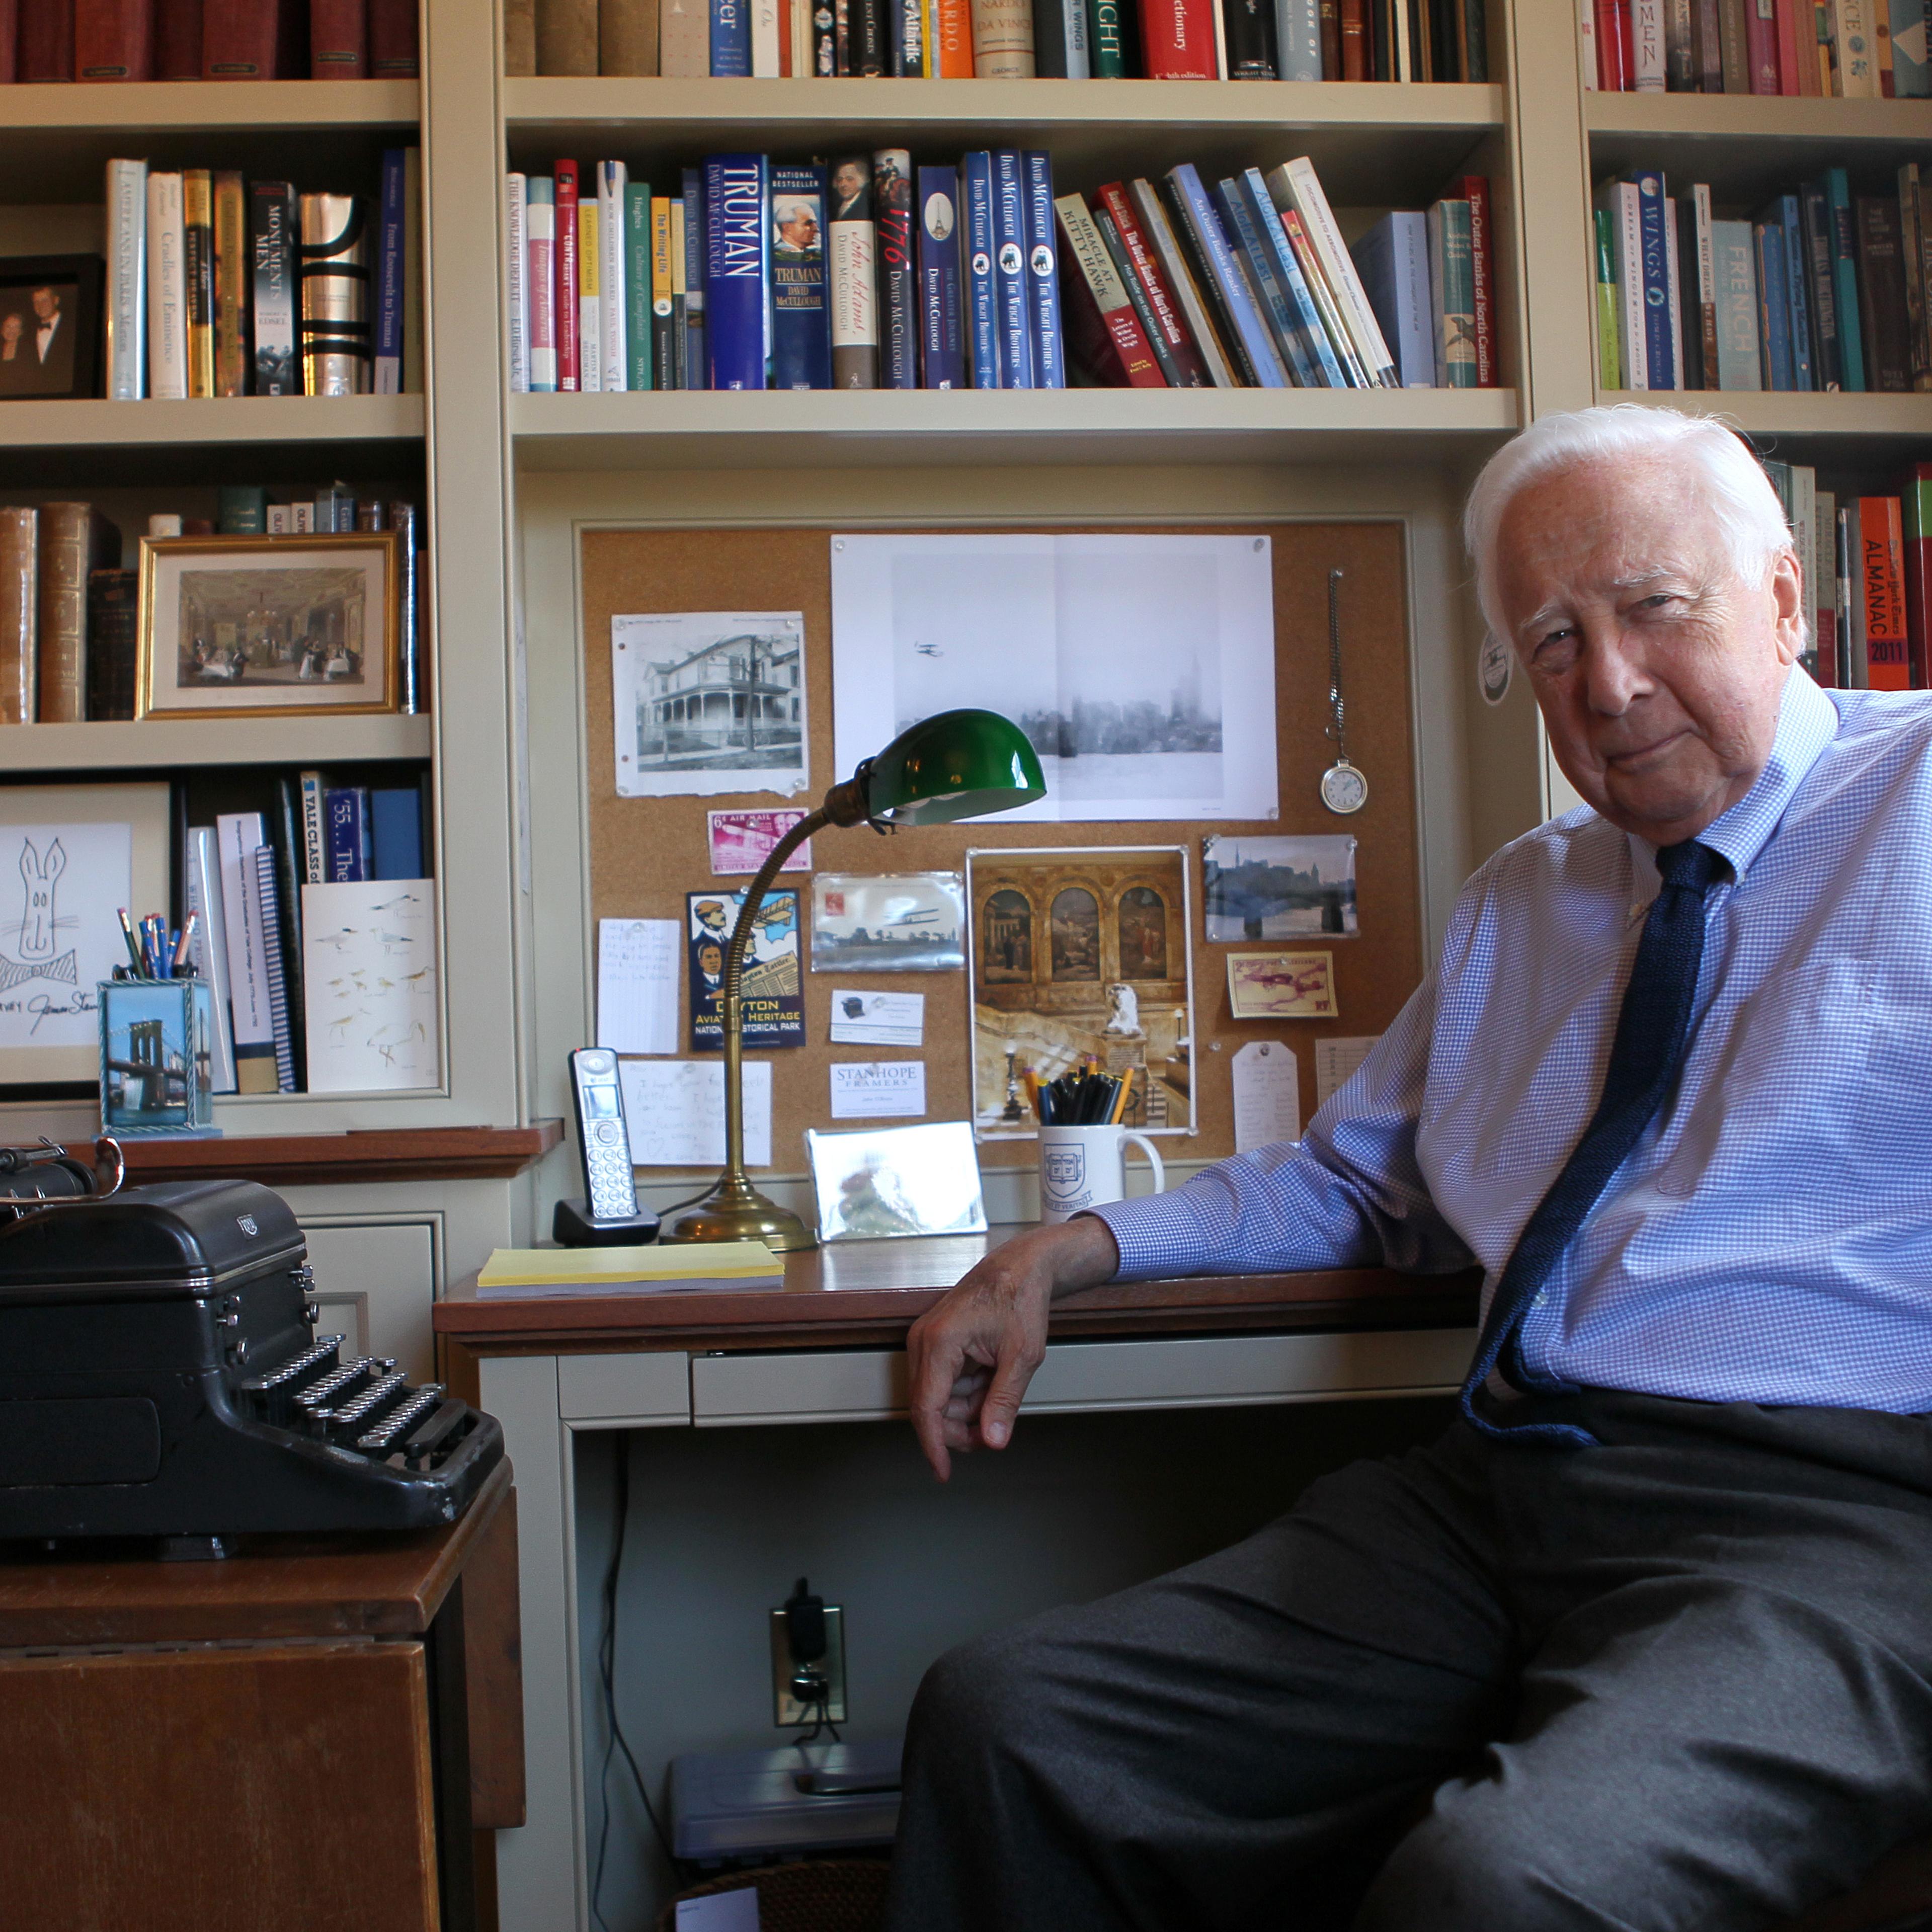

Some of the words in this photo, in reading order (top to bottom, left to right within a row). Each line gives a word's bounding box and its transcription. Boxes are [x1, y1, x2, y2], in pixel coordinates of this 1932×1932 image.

[1073, 11, 1084, 51] WINGS
[707, 164, 721, 198] DAVID
[1000, 155, 1015, 180] DAVID
[1031, 157, 1045, 181] DAVID
[509, 180, 520, 195] THE
[974, 179, 985, 200] DAVID
[632, 197, 643, 229] Hughes
[657, 213, 667, 226] The
[1472, 193, 1483, 215] The
[386, 223, 398, 249] From
[723, 164, 761, 277] TRUMAN
[1473, 215, 1483, 251] Outer
[256, 234, 270, 270] MEN
[269, 205, 281, 299] MONUMENTS
[657, 228, 667, 257] Writing
[838, 234, 847, 263] DAVID
[851, 231, 871, 269] John
[878, 209, 910, 271] 1776
[1064, 210, 1090, 252] KITTY
[1084, 256, 1108, 298] HAWK
[1079, 218, 1107, 266] MIRACLE
[1101, 270, 1114, 282] AT
[1125, 231, 1138, 246] The
[1194, 197, 1206, 211] An
[1201, 211, 1216, 238] Outer
[1212, 238, 1228, 267] Banks
[1223, 267, 1241, 298] Reader
[1644, 206, 1661, 278] WINGS
[160, 230, 174, 280] Cradles
[586, 249, 594, 290] OPTIMISM
[659, 258, 668, 273] Life
[1131, 244, 1147, 266] Outer
[1474, 251, 1485, 286] Banks
[385, 251, 397, 296] Roosevelt
[775, 268, 822, 282] TRUMAN
[890, 271, 902, 302] DAVID
[928, 268, 939, 293] DAVID
[978, 280, 988, 292] THE
[1007, 280, 1019, 294] THE
[1038, 282, 1051, 296] THE
[1140, 264, 1157, 287] Banks
[163, 285, 174, 298] of
[385, 298, 394, 308] to
[776, 296, 821, 306] McCULLOUGH
[788, 286, 809, 295] DAVID
[852, 273, 870, 331] Adams
[1152, 292, 1171, 315] North
[1476, 287, 1487, 300] of
[1729, 247, 1755, 352] FRENCH
[979, 294, 989, 320] WRIGHT
[1008, 296, 1020, 327] WRIGHT
[1040, 298, 1052, 329] WRIGHT
[1477, 301, 1488, 334] North
[162, 300, 175, 363] Eminence
[383, 310, 394, 347] Truman
[979, 321, 990, 355] BROTHERS
[1162, 313, 1181, 344] Carolina
[1010, 329, 1022, 368] BROTHERS
[1042, 331, 1054, 370] BROTHERS
[1479, 335, 1490, 383] Carolina
[1865, 538, 1887, 635] ALMANAC
[1887, 581, 1900, 604] York
[1890, 605, 1902, 634] Times
[1871, 641, 1903, 661] 2011
[305, 796, 316, 828] YALE
[308, 829, 319, 870] CLASS
[336, 847, 353, 881] The
[716, 1001, 778, 1012] DYTON
[748, 1011, 800, 1021] HERITAGE
[780, 1021, 800, 1030] PARK
[837, 1067, 917, 1081] STANHOPE
[845, 1079, 909, 1087] FRAMERS
